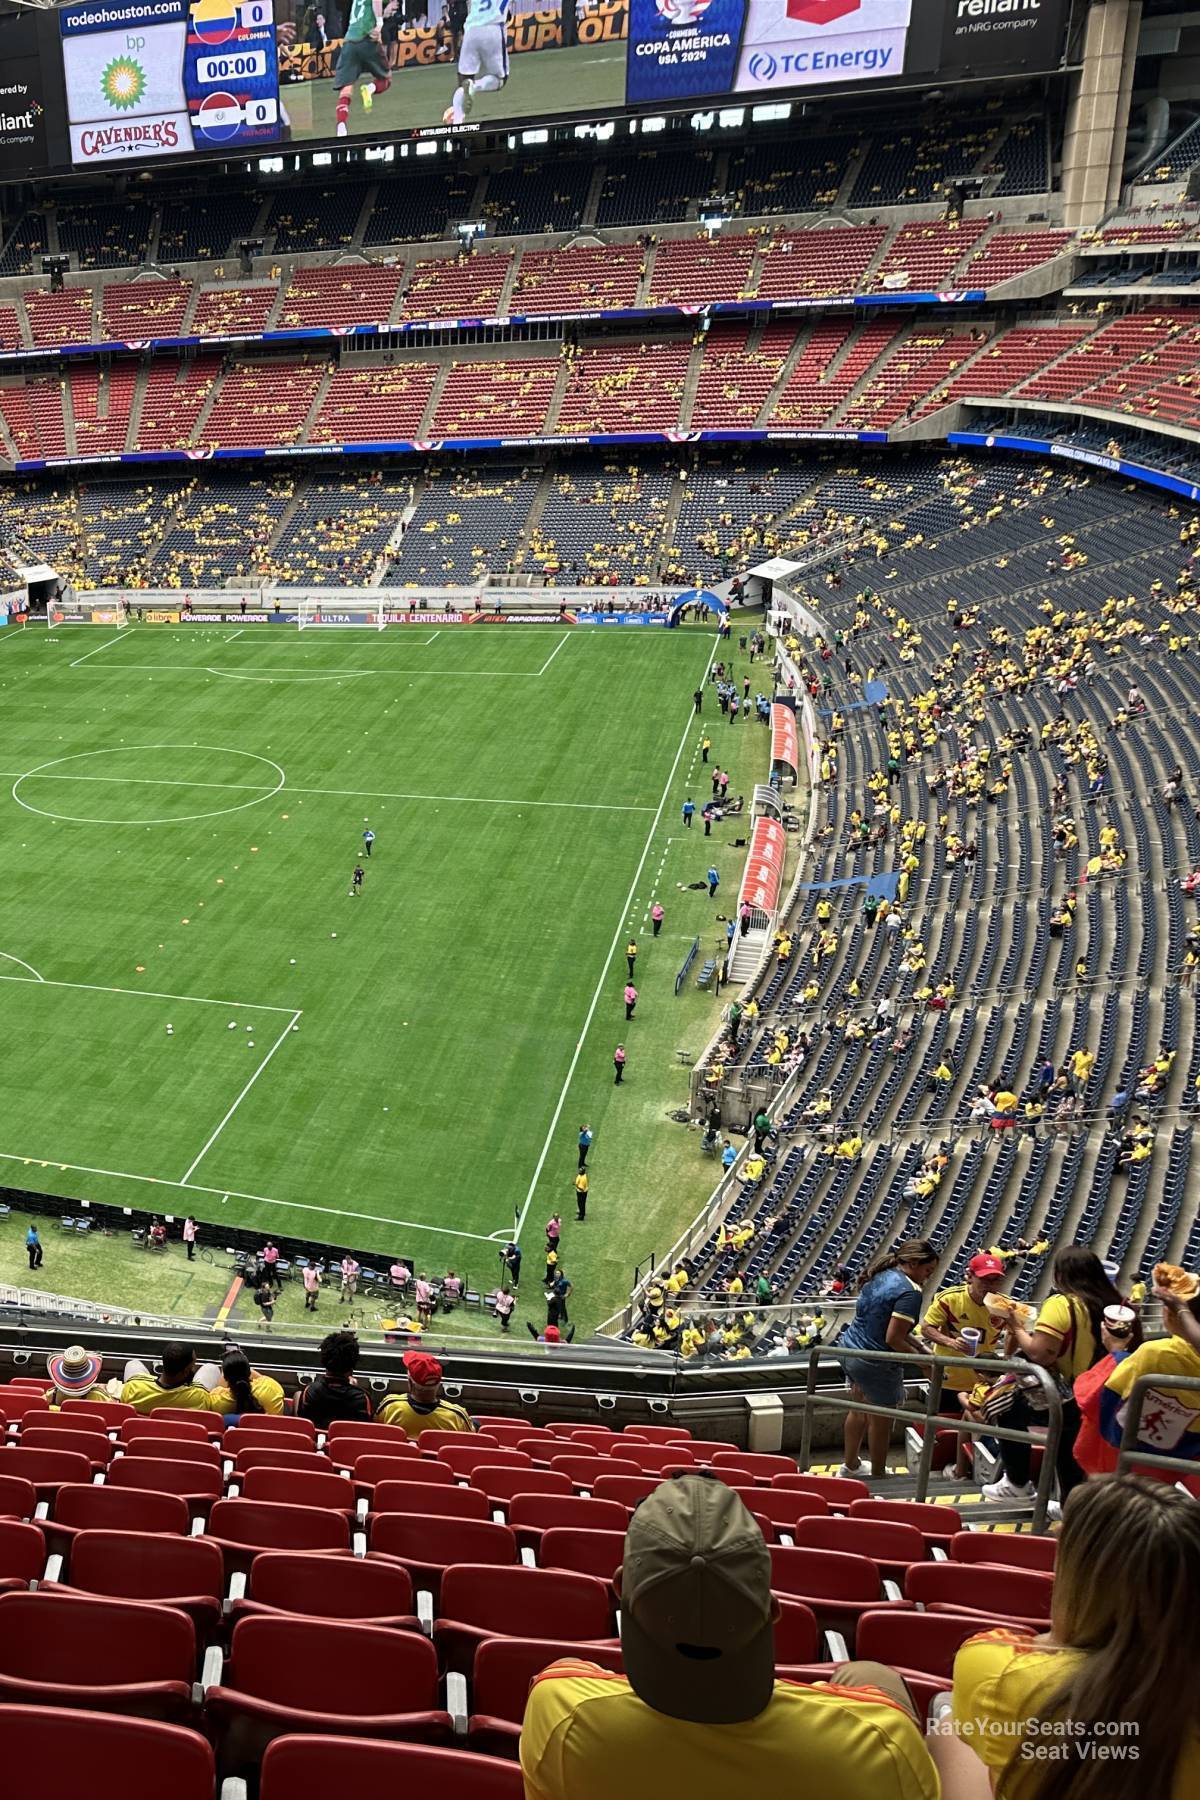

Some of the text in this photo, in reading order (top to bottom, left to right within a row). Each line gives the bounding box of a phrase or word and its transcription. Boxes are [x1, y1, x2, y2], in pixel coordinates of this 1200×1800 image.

[67, 2, 181, 27] rodeohouston.com
[252, 6, 263, 22] 0
[955, 19, 1037, 35] an NRG company
[126, 35, 145, 52] bp
[238, 31, 271, 41] COLOMBIA
[636, 34, 730, 56] COPA AMERICA
[658, 51, 707, 65] USA 2024
[781, 47, 892, 73] TC Energy
[207, 57, 257, 78] 00:00
[17, 84, 28, 95] by
[256, 105, 266, 121] 0
[81, 121, 179, 155] CAVENDER'S
[420, 124, 480, 136] MITSUBISHI ELECTRIC
[6, 135, 34, 145] company
[181, 614, 222, 622] POWERADE
[225, 614, 268, 622] POWERADE
[410, 613, 463, 622] CENTENARIO
